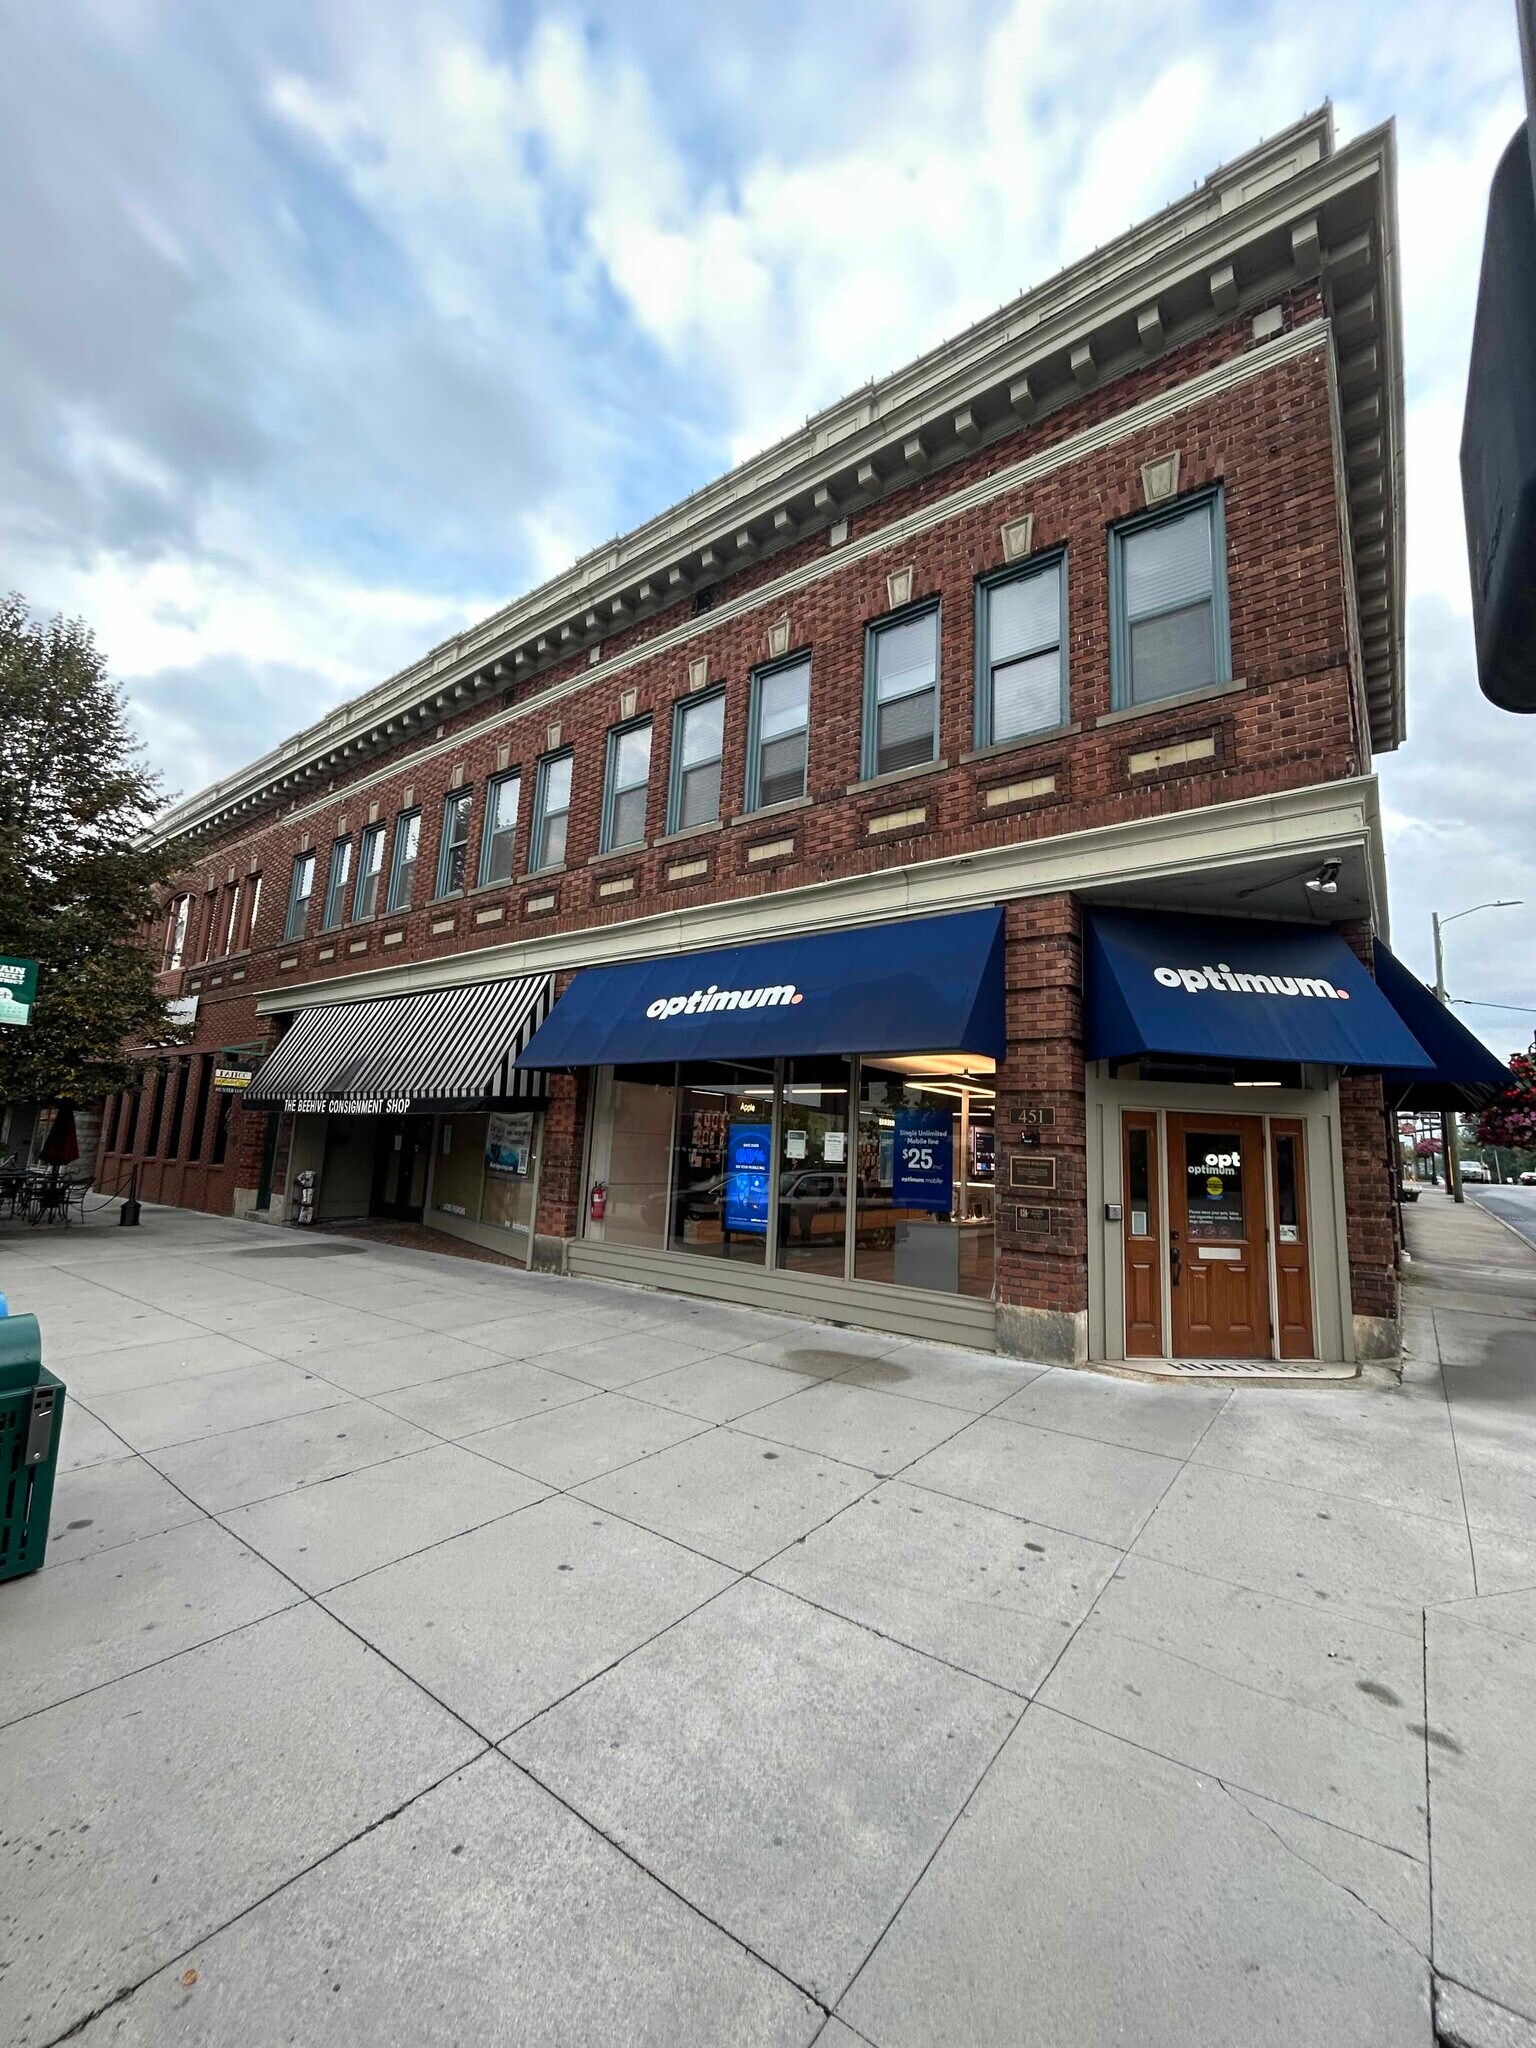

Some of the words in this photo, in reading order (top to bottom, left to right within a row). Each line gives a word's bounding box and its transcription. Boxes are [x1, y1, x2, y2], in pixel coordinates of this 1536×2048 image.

[0, 964, 26, 975] AIN
[284, 1099, 297, 1112] THE
[297, 1099, 326, 1113] BEEHIVE
[328, 1099, 383, 1114] CONSIGNMENT
[385, 1098, 410, 1114] SHOP
[740, 1102, 755, 1112] Apple
[1018, 1109, 1044, 1124] 451
[907, 1137, 927, 1145] Mobile
[902, 1147, 933, 1169] $25
